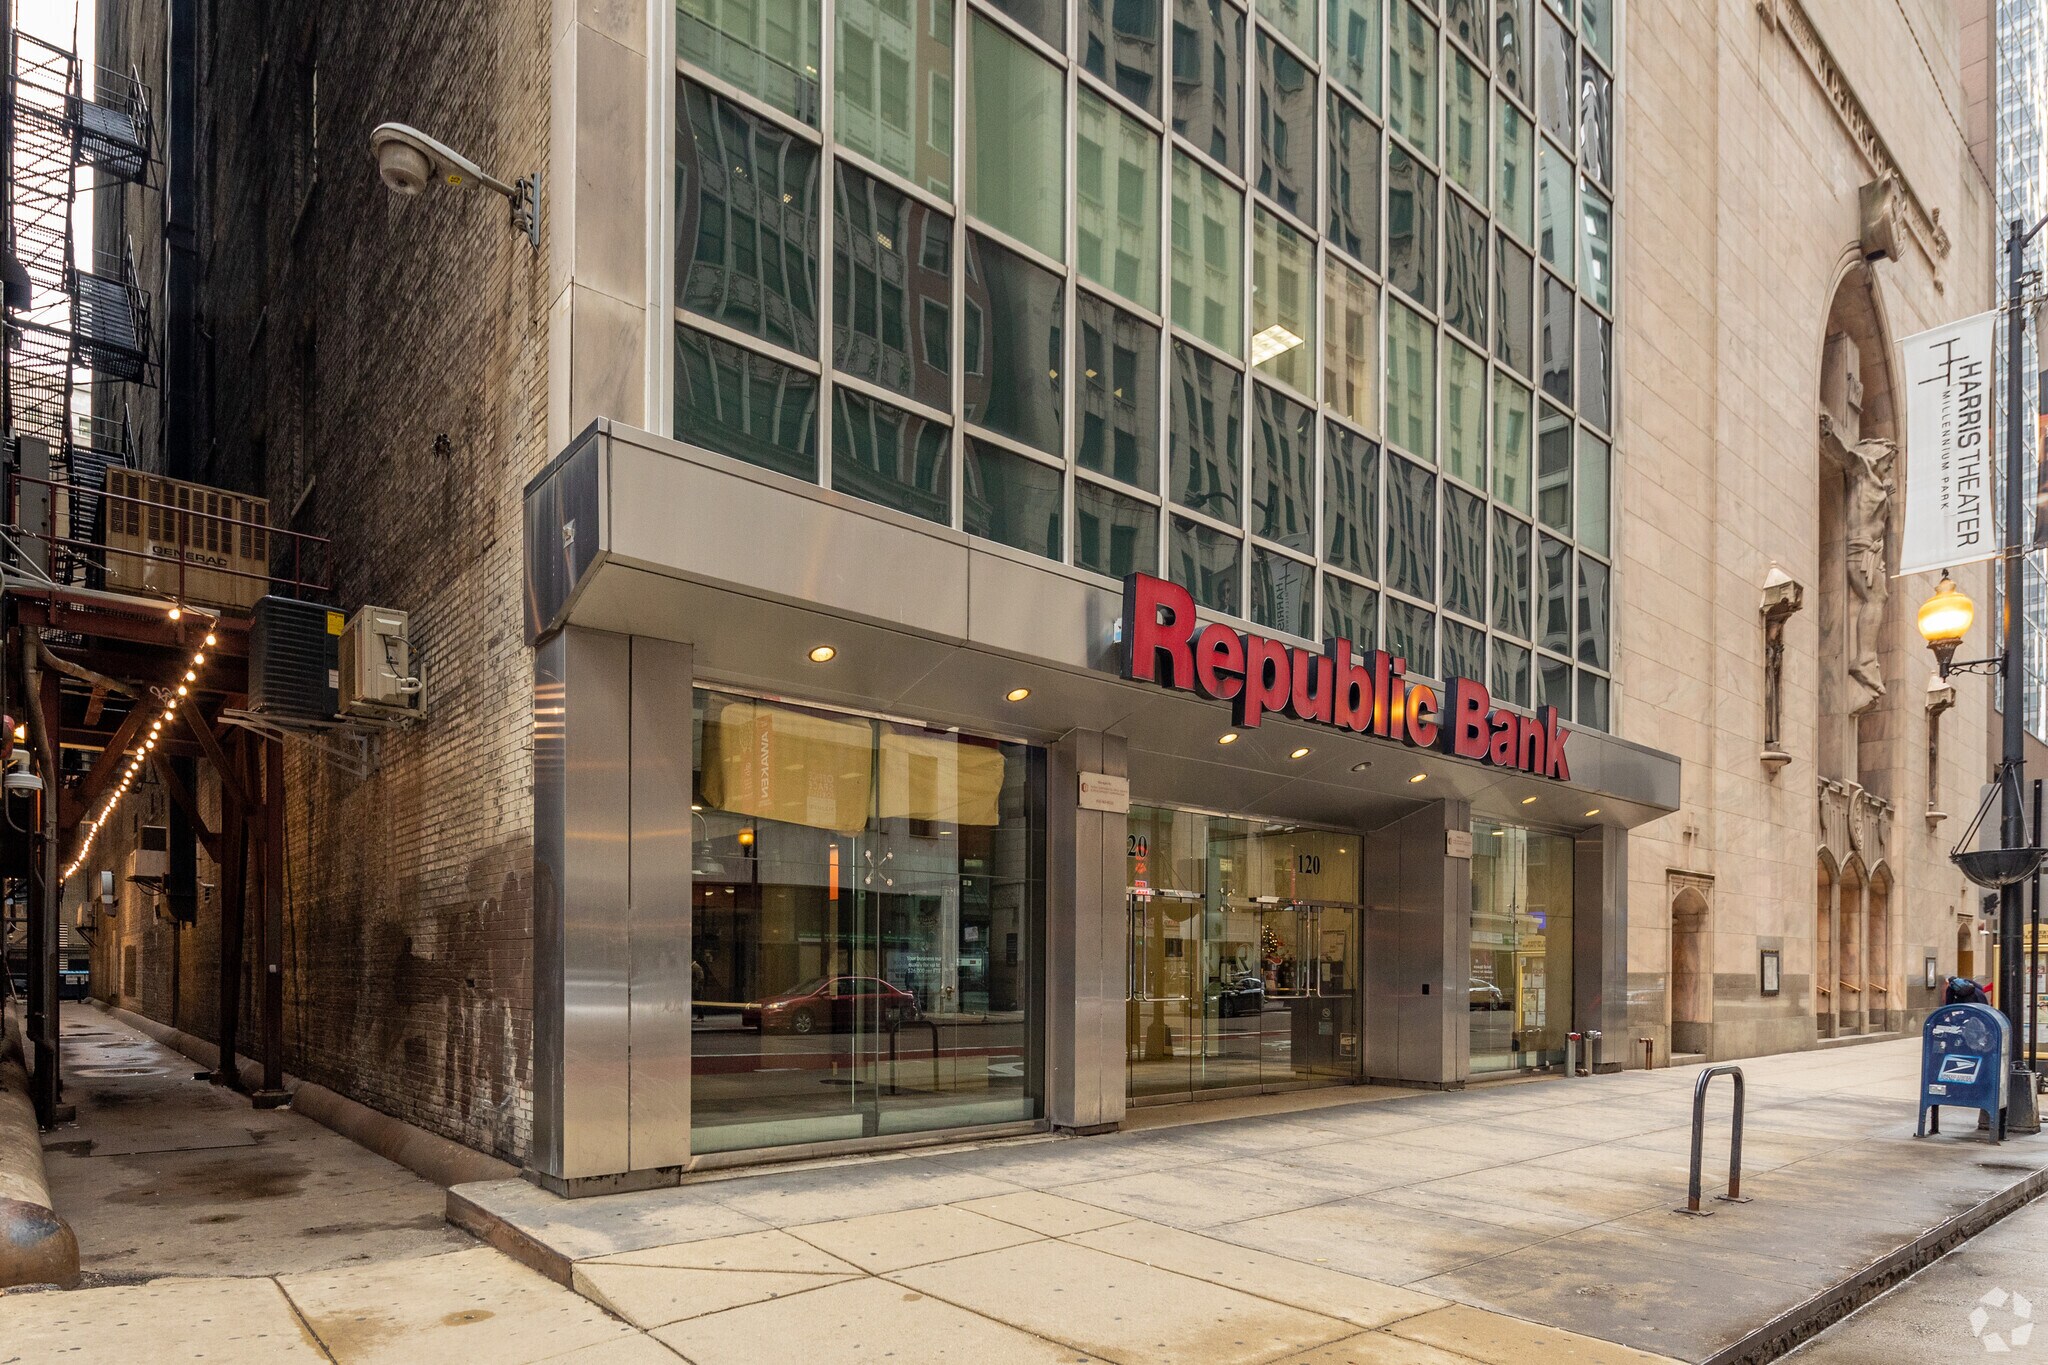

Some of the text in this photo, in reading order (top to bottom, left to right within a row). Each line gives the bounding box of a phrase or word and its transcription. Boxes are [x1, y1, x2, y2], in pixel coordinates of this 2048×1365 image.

[1940, 390, 1951, 510] MILLENNIUM PARK
[1957, 361, 1982, 548] HARRIS THEATER
[152, 545, 227, 567] GENERAC
[1131, 572, 1572, 781] Republic Bank
[1127, 834, 1148, 858] 20
[1298, 854, 1321, 875] 120
